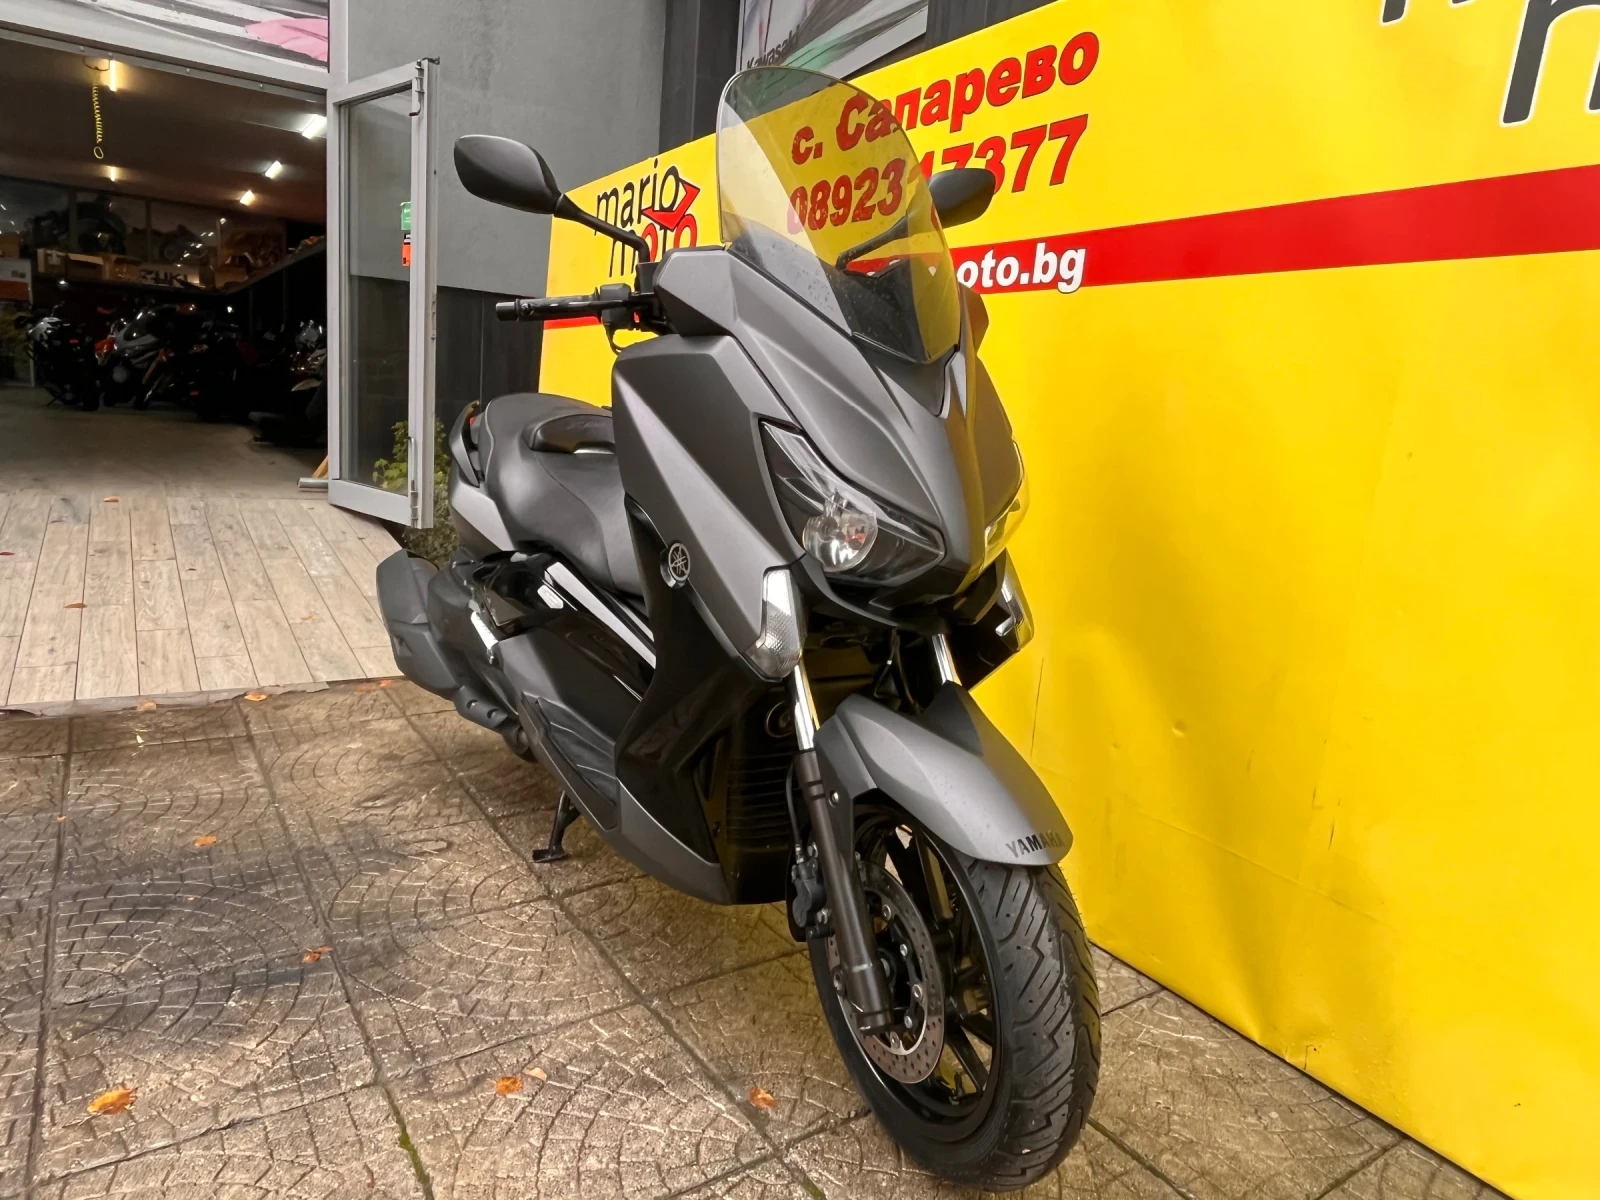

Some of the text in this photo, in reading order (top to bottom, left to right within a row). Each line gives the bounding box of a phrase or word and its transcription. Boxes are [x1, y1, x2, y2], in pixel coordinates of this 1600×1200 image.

[835, 31, 1100, 152] Сапарево
[594, 157, 680, 236] mario
[955, 241, 1087, 294] oto.bg
[1004, 830, 1066, 858] YAMAHA
